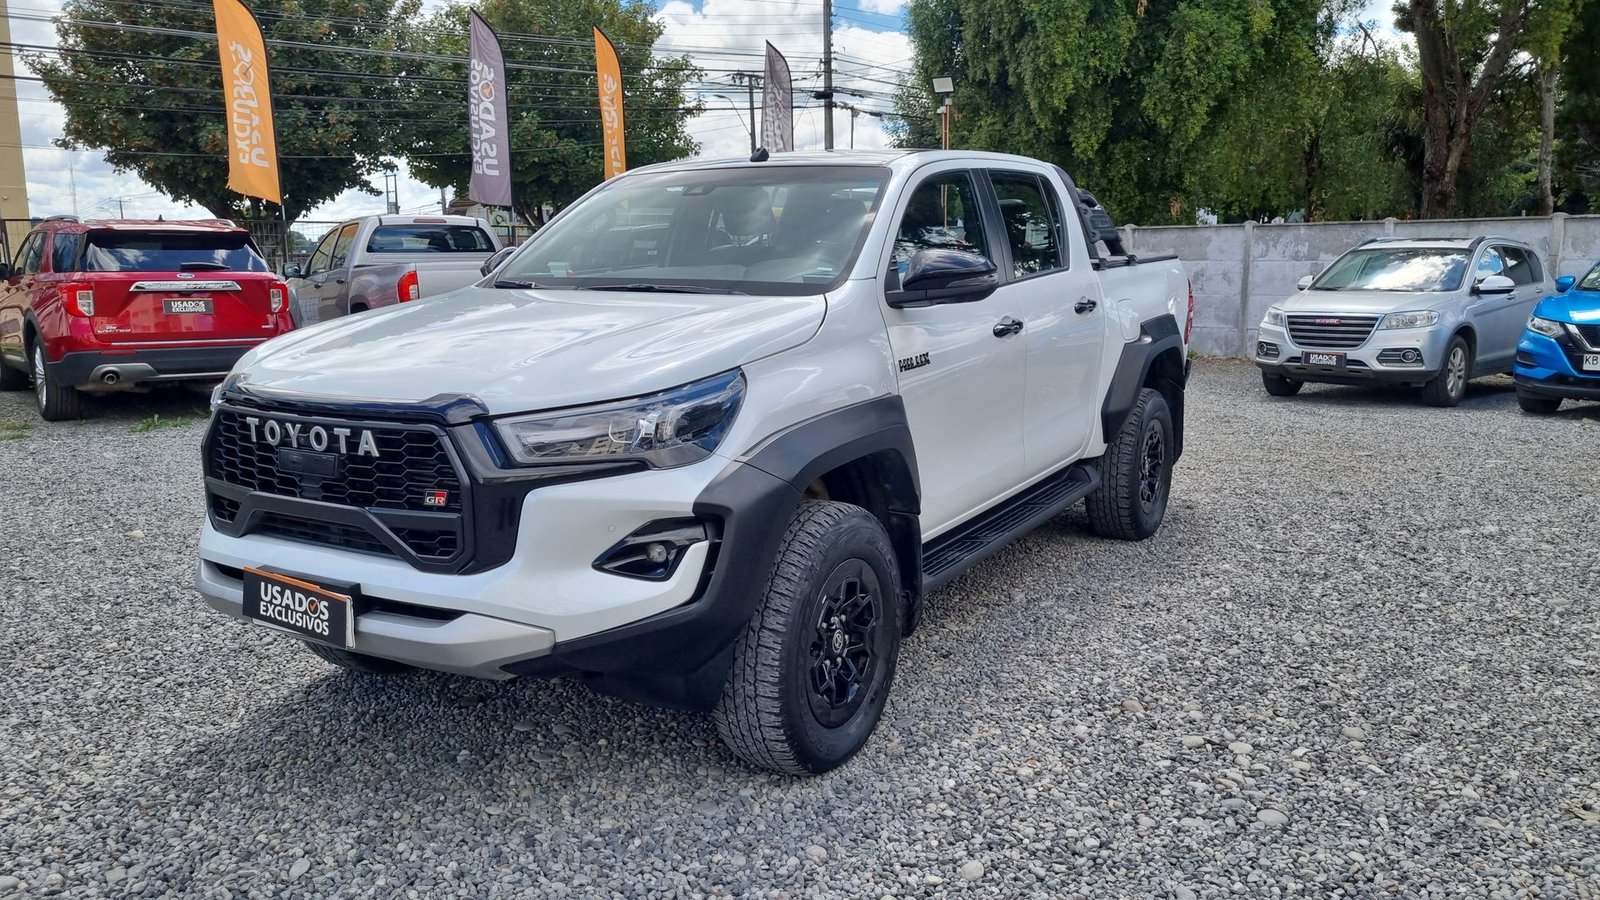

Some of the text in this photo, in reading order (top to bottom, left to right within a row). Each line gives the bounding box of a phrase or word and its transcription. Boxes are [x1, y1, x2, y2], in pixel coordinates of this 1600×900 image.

[171, 301, 206, 309] USADOS
[1310, 353, 1337, 361] USADOS
[246, 416, 380, 458] TOYOTA
[426, 496, 446, 505] GR
[260, 581, 329, 621] USADOS
[259, 601, 329, 636] EXCLUSIVOS
